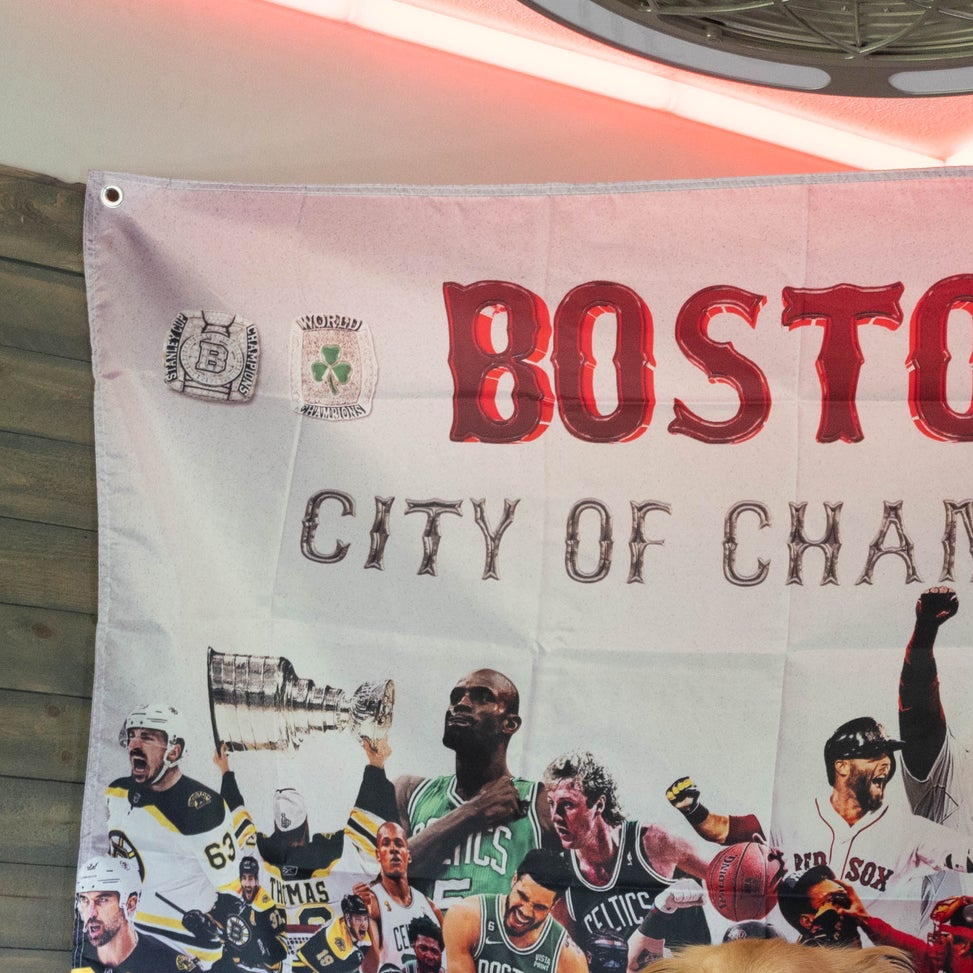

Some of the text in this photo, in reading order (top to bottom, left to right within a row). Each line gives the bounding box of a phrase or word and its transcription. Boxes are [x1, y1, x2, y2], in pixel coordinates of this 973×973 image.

[298, 314, 363, 331] WORLD
[165, 312, 188, 382] STANLEY CUP
[238, 324, 259, 397] CHAMPIONS
[300, 403, 366, 419] CHAMPIONS
[301, 488, 521, 581] CITY
[565, 497, 672, 584] OF
[204, 832, 236, 870] 63
[845, 857, 894, 892] SOX
